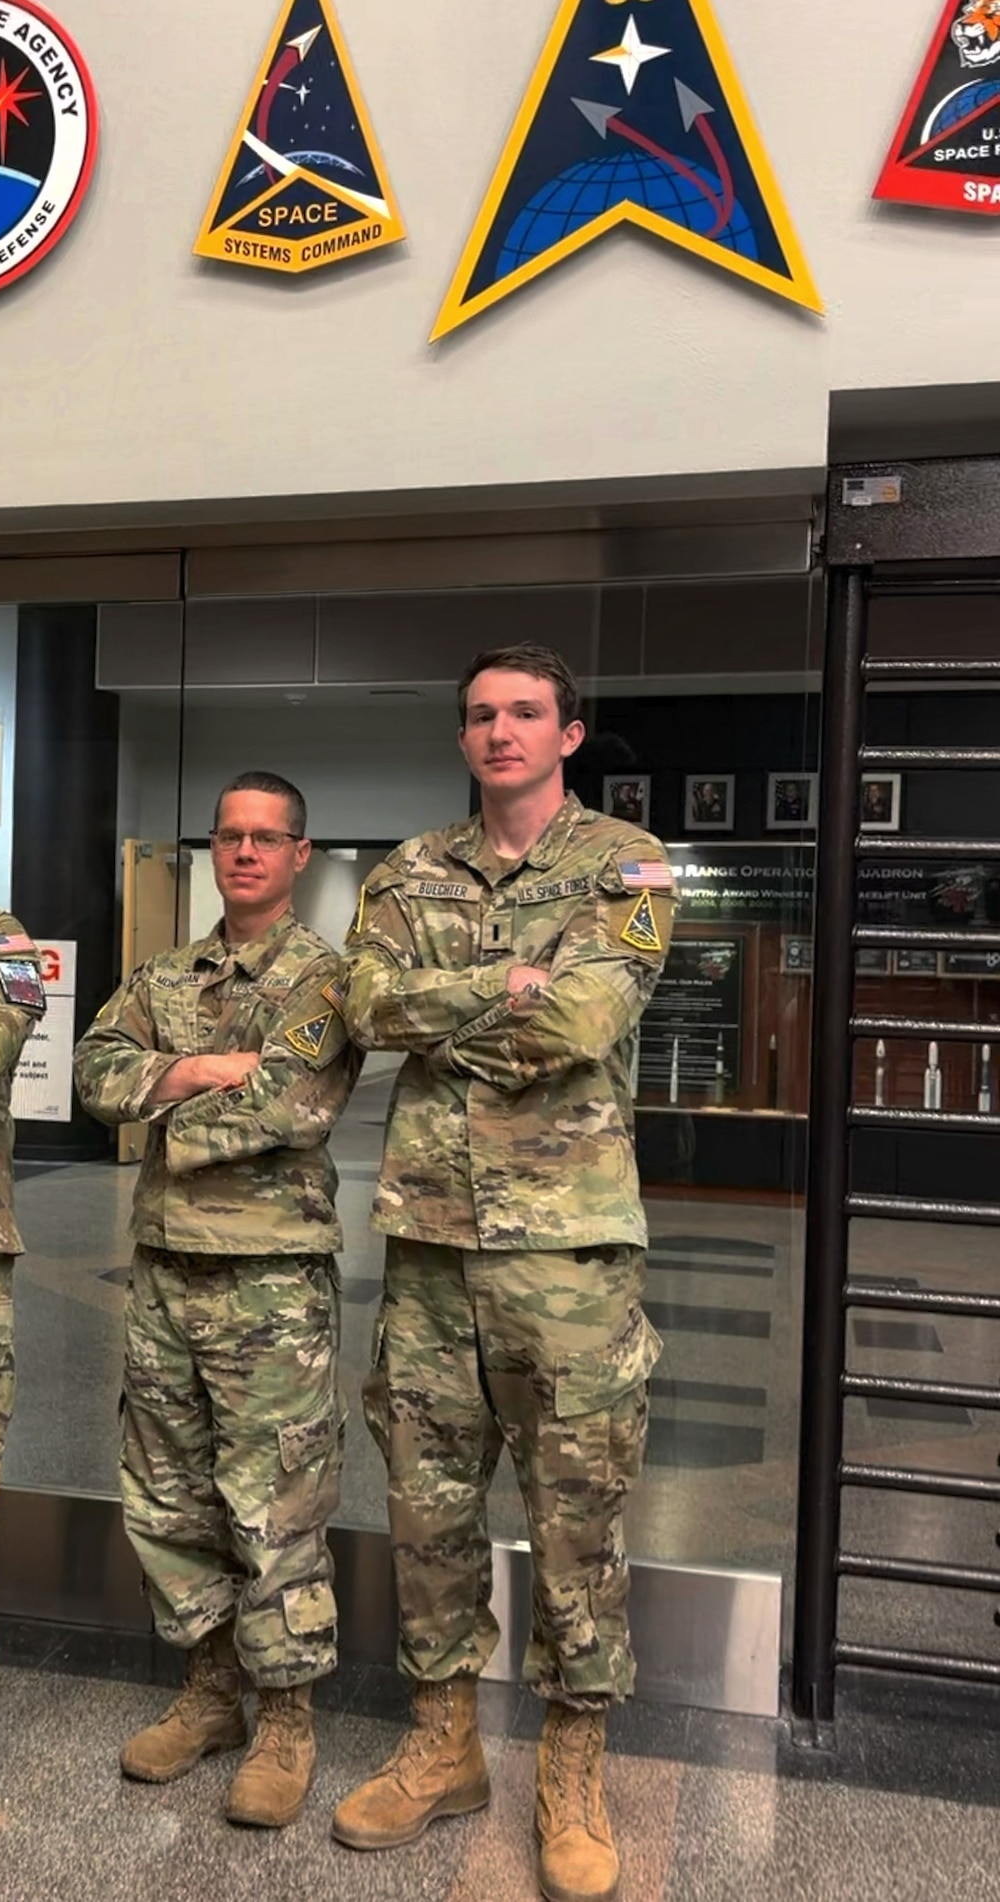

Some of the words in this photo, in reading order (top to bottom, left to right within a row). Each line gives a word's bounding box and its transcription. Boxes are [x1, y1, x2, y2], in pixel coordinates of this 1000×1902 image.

[14, 23, 79, 118] AGENCY
[934, 145, 990, 162] SPACE
[258, 202, 338, 227] SPACE
[224, 237, 291, 263] SYSTEMS
[301, 224, 382, 262] COMMAND
[418, 882, 468, 898] BUECHTER
[537, 884, 563, 898] SPACE
[564, 877, 590, 893] FORCE
